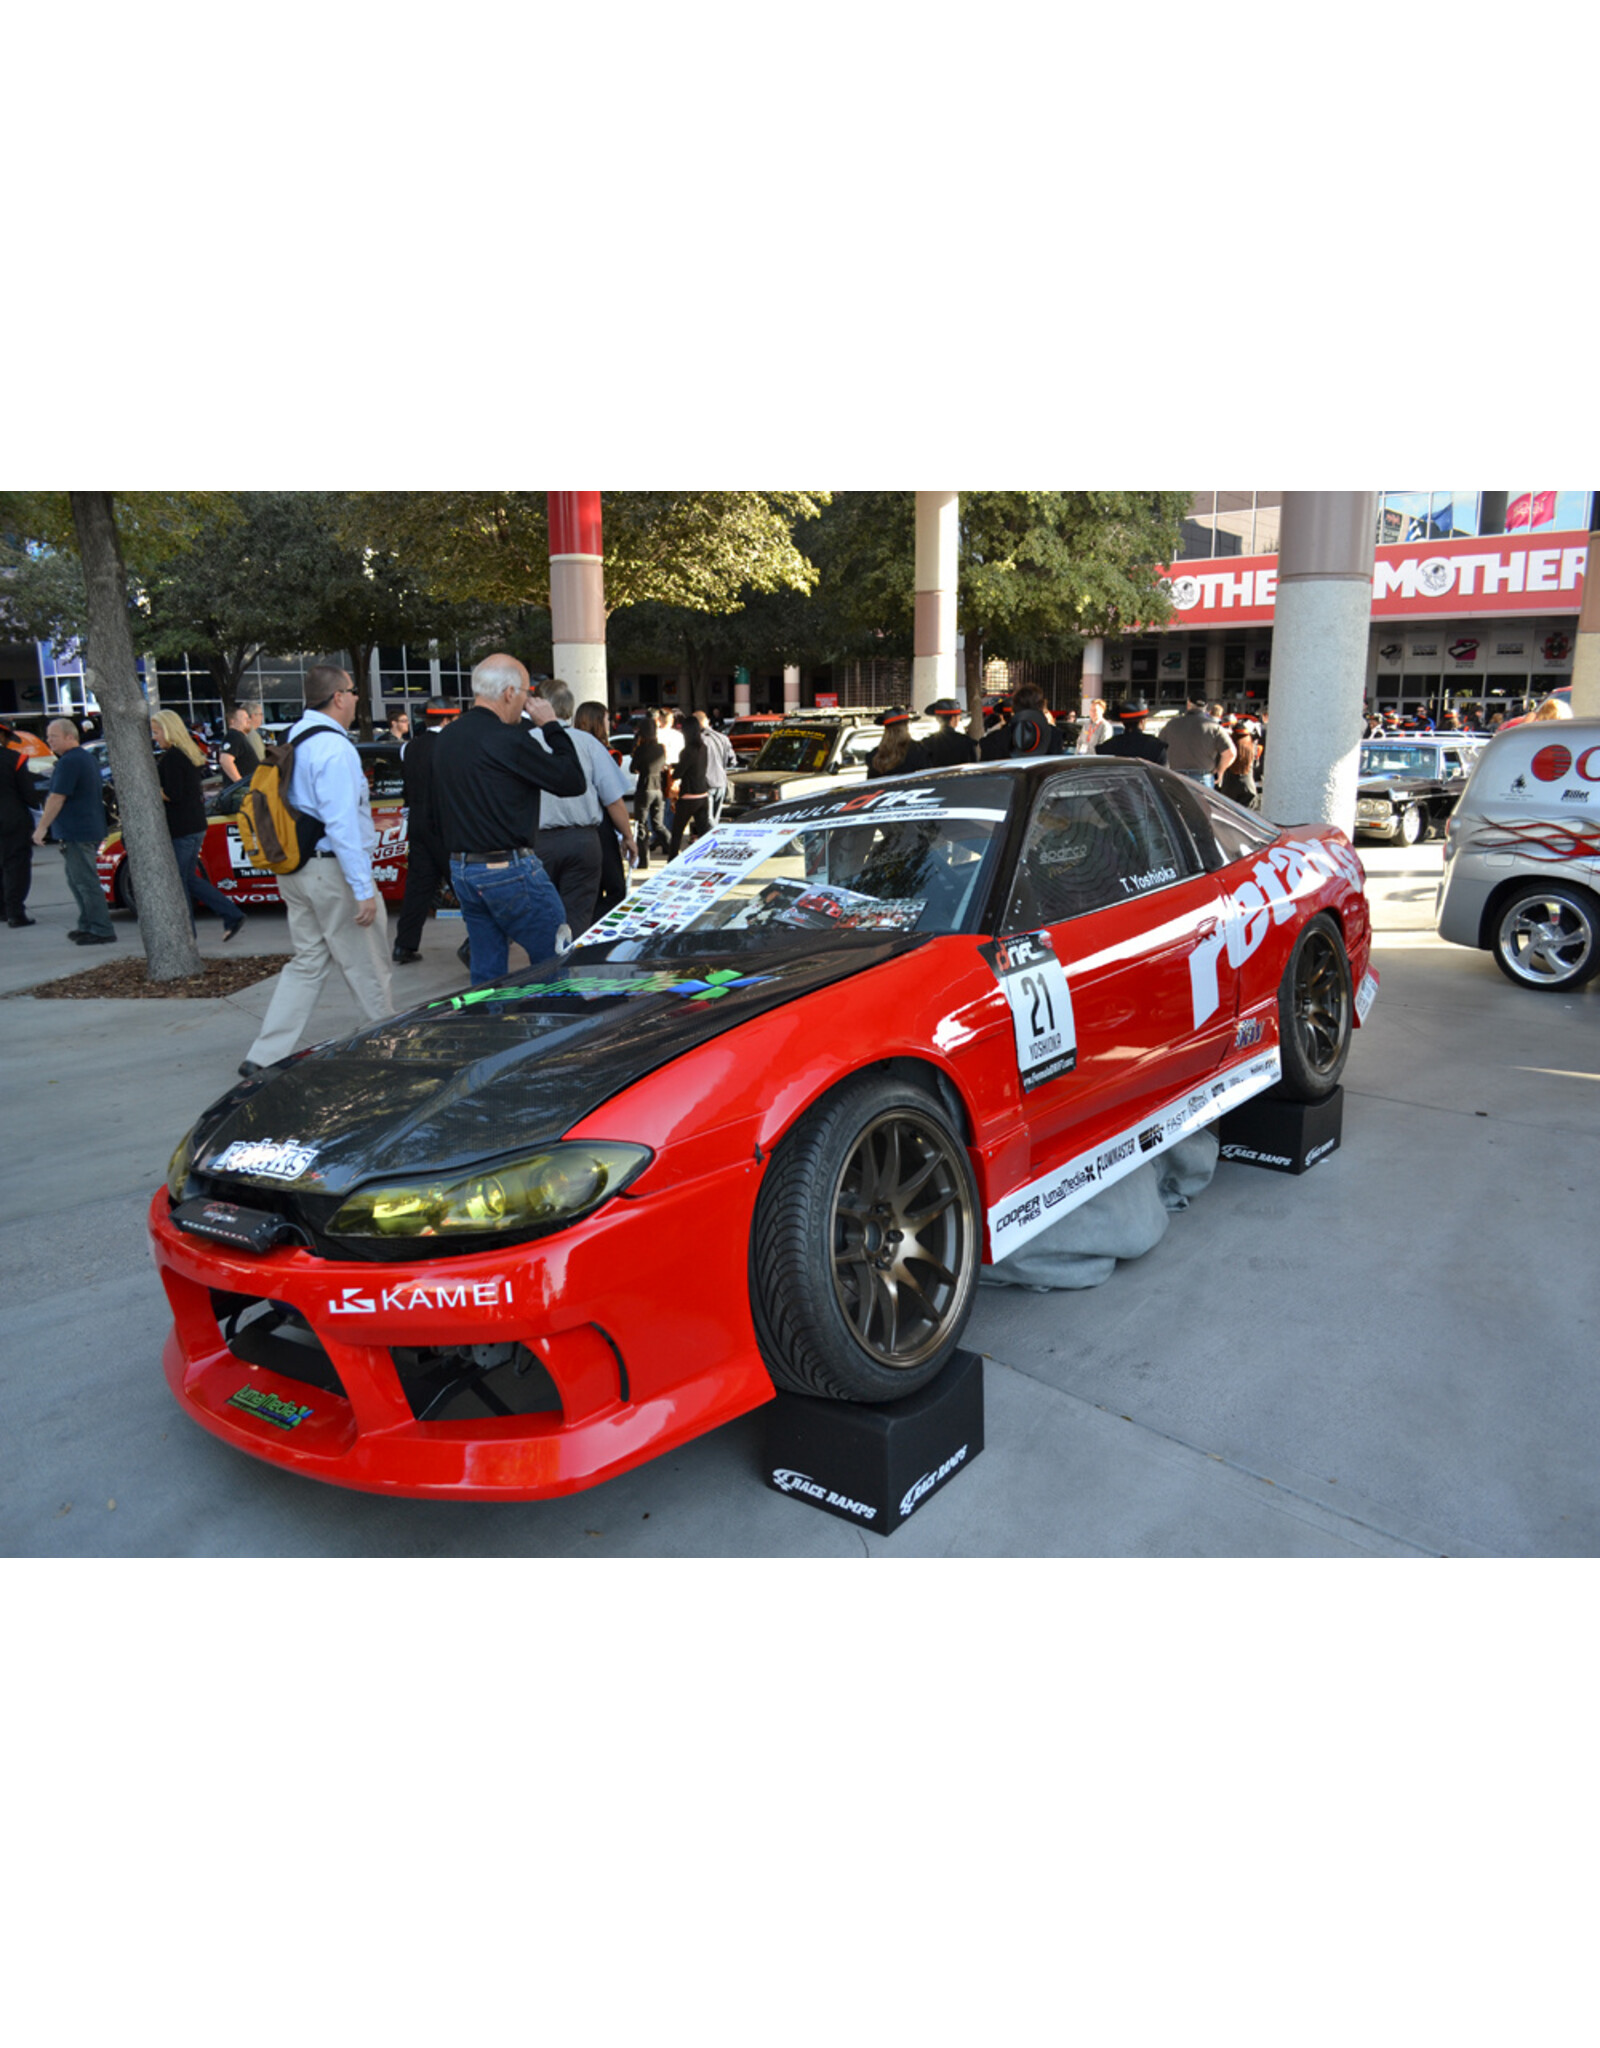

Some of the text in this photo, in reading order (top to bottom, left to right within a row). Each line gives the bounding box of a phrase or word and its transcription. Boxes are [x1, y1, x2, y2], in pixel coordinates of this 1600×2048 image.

[1159, 569, 1278, 610] OTHE
[1373, 547, 1588, 600] MOTHER
[1133, 865, 1177, 891] Yoshioka
[1020, 972, 1056, 1038] 21
[1029, 1032, 1062, 1061] YOSHIOKA
[1166, 1109, 1188, 1131] FAST
[1096, 1137, 1136, 1180] FLOWMASTER
[1235, 1148, 1293, 1166] RACE RAMPS
[996, 1195, 1041, 1233] COOPER
[1017, 1207, 1042, 1228] TIRES
[381, 1281, 514, 1311] KAMEI
[914, 1444, 968, 1502] RACE RAMPS
[792, 1477, 878, 1520] RACE RAMPS
